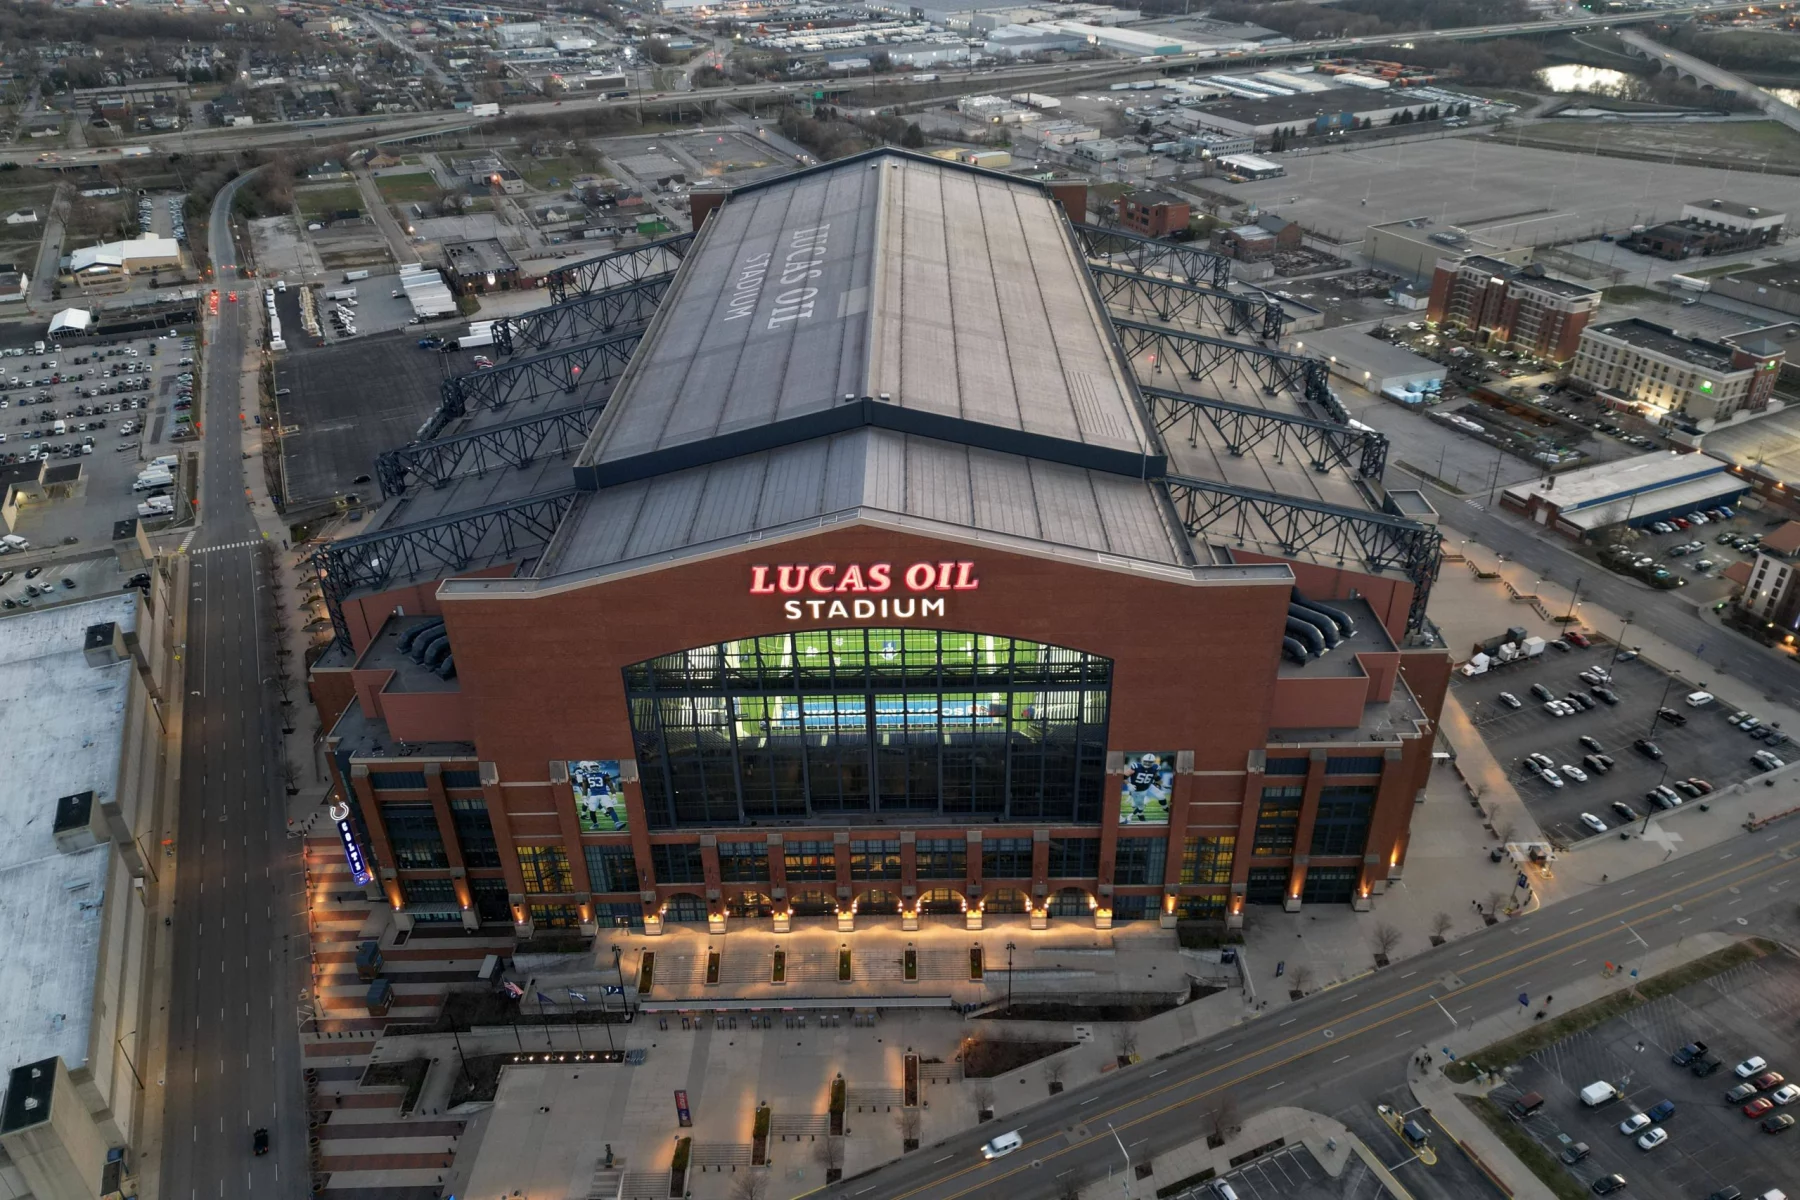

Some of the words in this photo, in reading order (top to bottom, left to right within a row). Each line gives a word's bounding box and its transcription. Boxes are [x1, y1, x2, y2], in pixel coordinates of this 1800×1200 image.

[780, 224, 830, 284] LUCAS
[724, 252, 771, 321] STADIUM
[768, 287, 818, 329] OIL
[750, 563, 891, 592] LUCAS
[905, 561, 979, 591] OIL
[785, 598, 945, 619] STADIUM
[588, 777, 603, 788] 53
[1135, 772, 1153, 784] 56
[341, 821, 361, 871] COLTS
